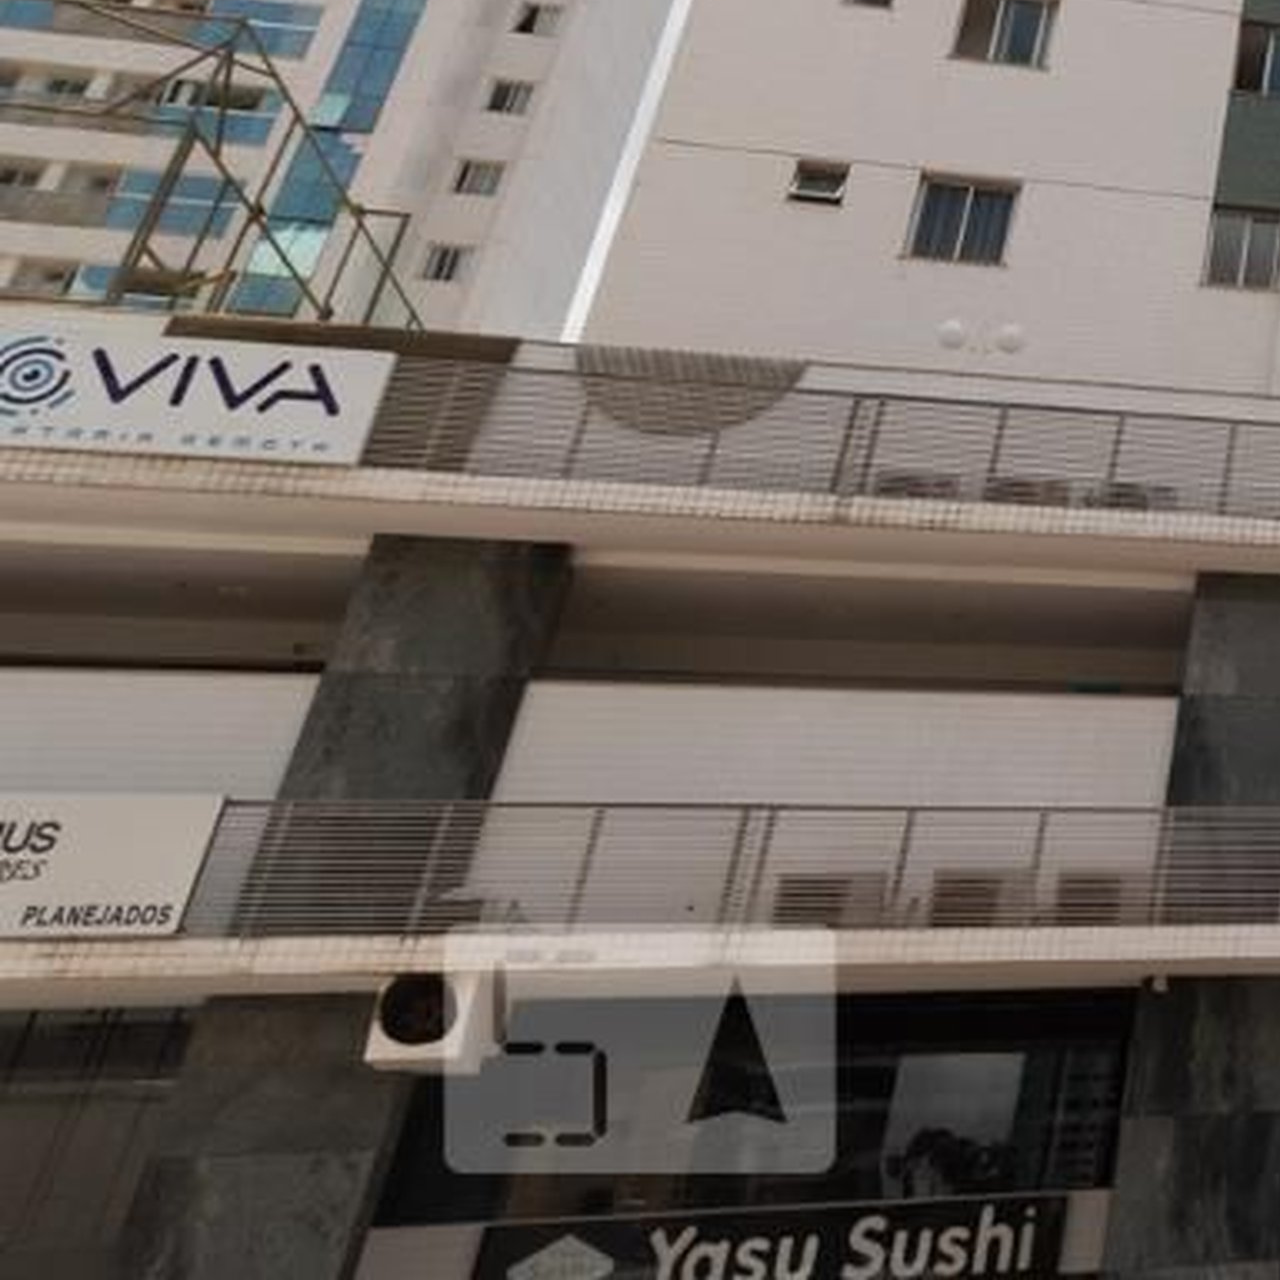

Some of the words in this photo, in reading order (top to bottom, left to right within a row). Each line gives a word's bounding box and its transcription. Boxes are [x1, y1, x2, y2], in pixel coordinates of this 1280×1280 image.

[93, 347, 340, 416] VIVA
[21, 905, 174, 927] PLANEJADOS
[841, 1205, 1037, 1278] Sushi
